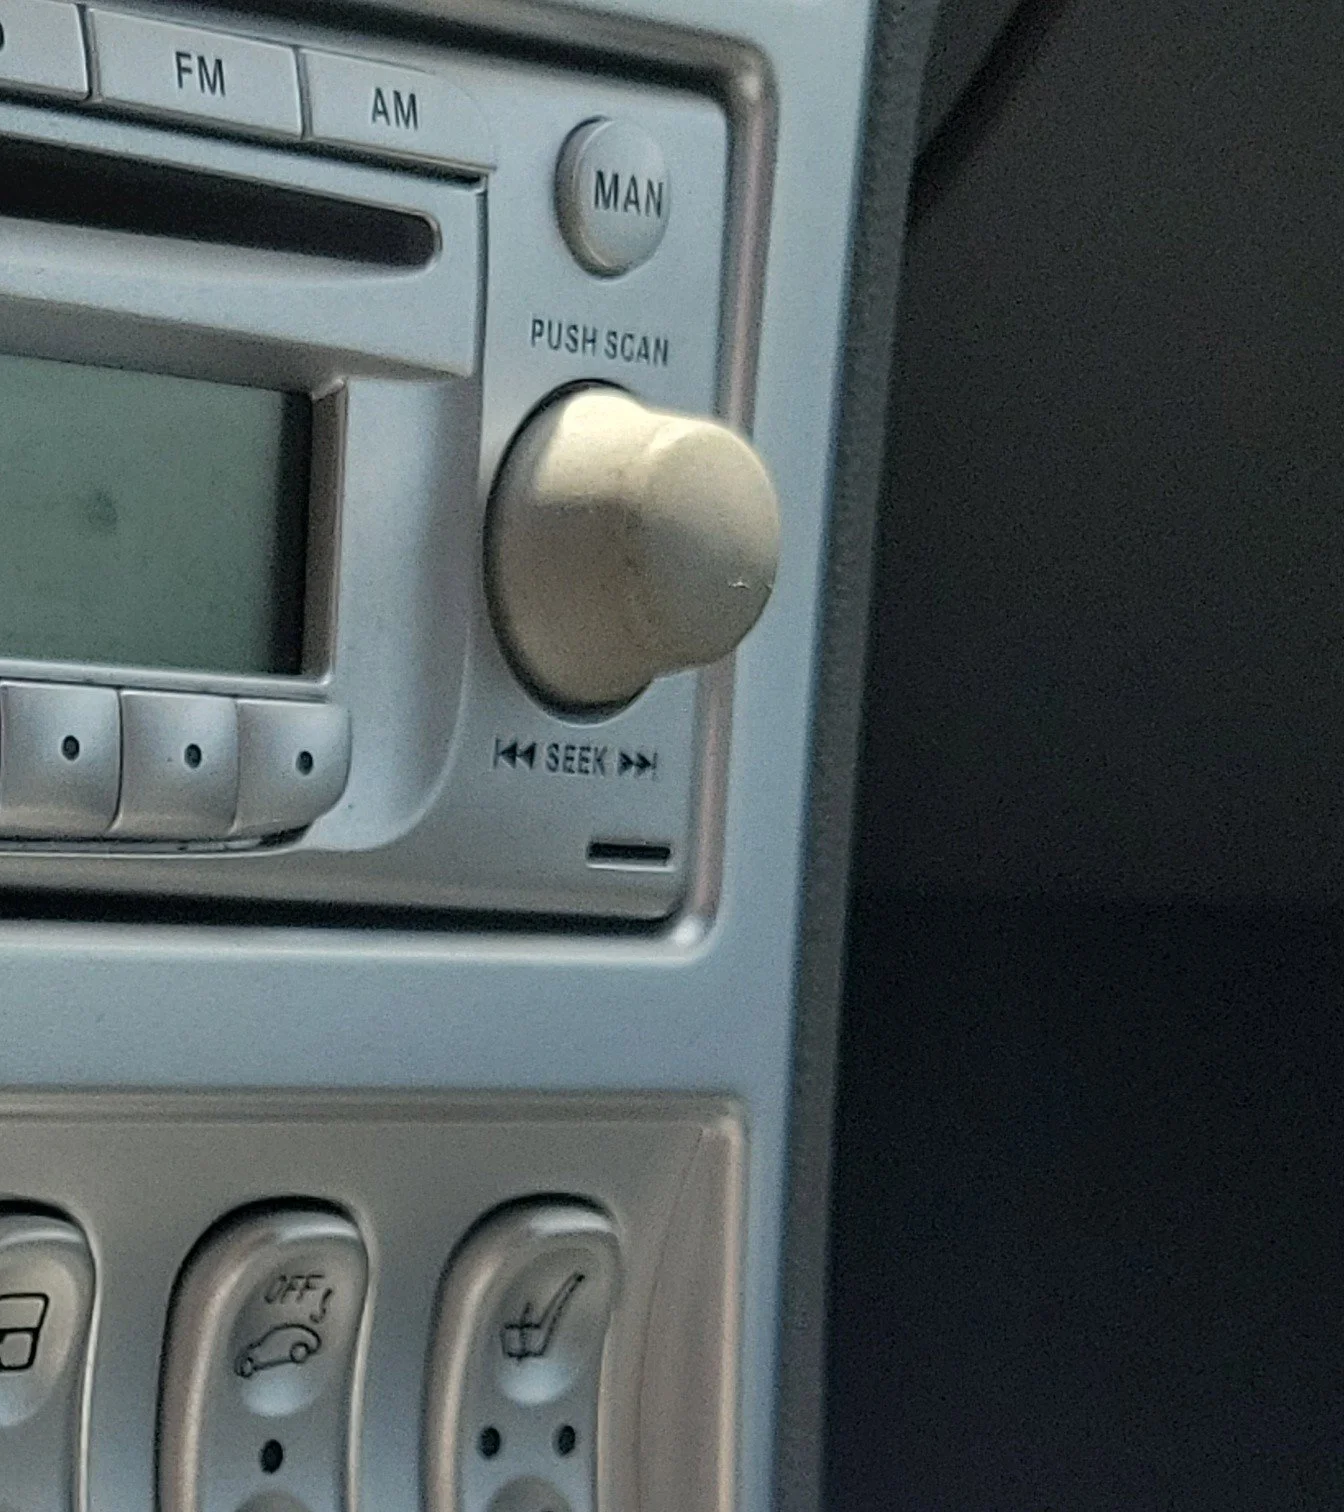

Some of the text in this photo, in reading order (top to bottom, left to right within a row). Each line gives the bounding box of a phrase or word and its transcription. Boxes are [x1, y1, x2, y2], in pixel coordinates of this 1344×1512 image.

[175, 51, 226, 97] FM
[370, 87, 419, 130] AM
[593, 169, 662, 219] MAN
[530, 318, 668, 366] PUSH SCAN
[544, 742, 608, 776] SEEK
[264, 1275, 325, 1304] OFF
